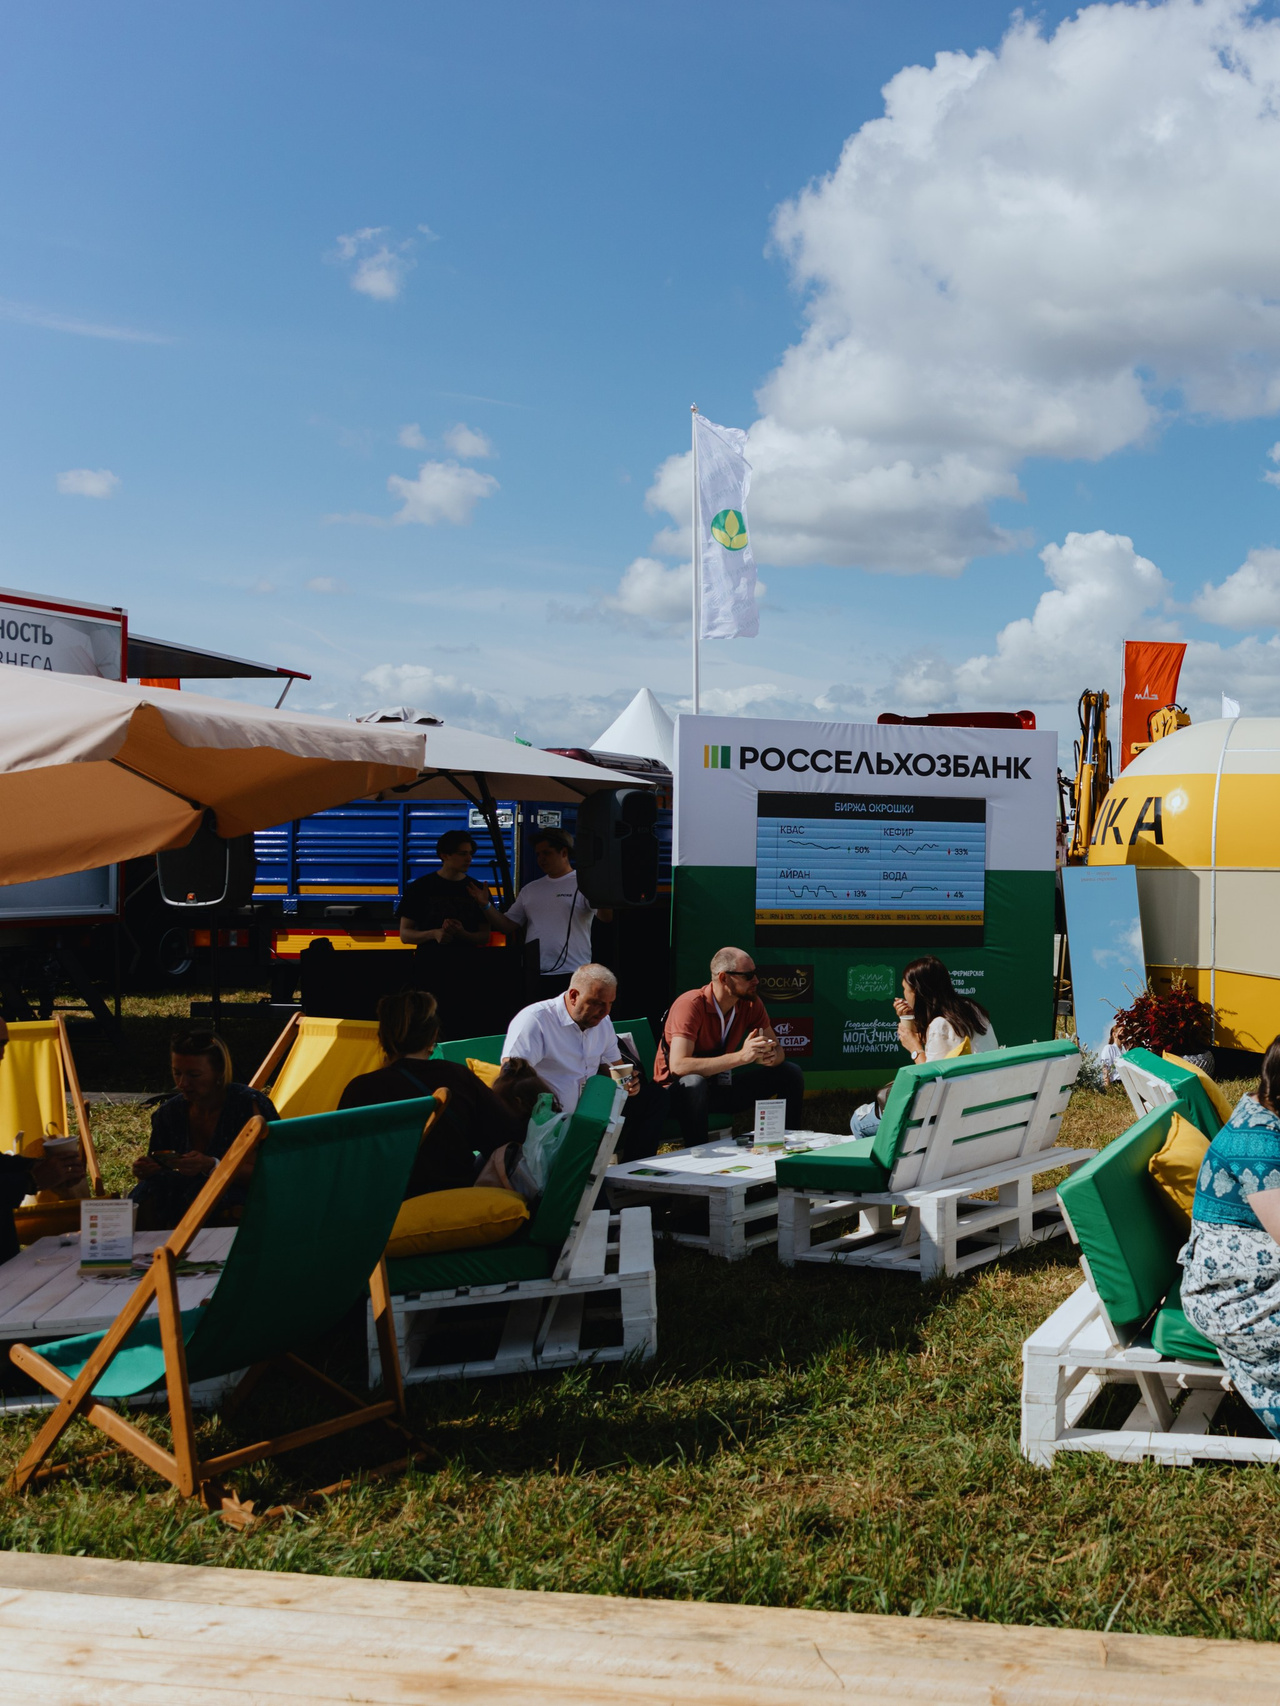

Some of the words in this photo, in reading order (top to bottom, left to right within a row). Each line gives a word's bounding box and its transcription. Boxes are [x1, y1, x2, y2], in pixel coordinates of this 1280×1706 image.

[739, 746, 1032, 780] РОССЕЛЬХОЗБАНК
[834, 802, 867, 812] БИРЖА
[869, 803, 914, 814] ОКРОШКИ
[1091, 796, 1164, 845] КА
[780, 825, 805, 835] КВАС
[883, 828, 914, 837] КЕФИР
[854, 846, 870, 854] 50%
[954, 848, 968, 856] 33%
[779, 867, 811, 879] АЙРАН
[882, 871, 908, 881] ВОДА
[854, 890, 867, 898] 13%
[953, 891, 964, 899] 4%
[842, 1044, 899, 1053] МАНУФАКТУРА
